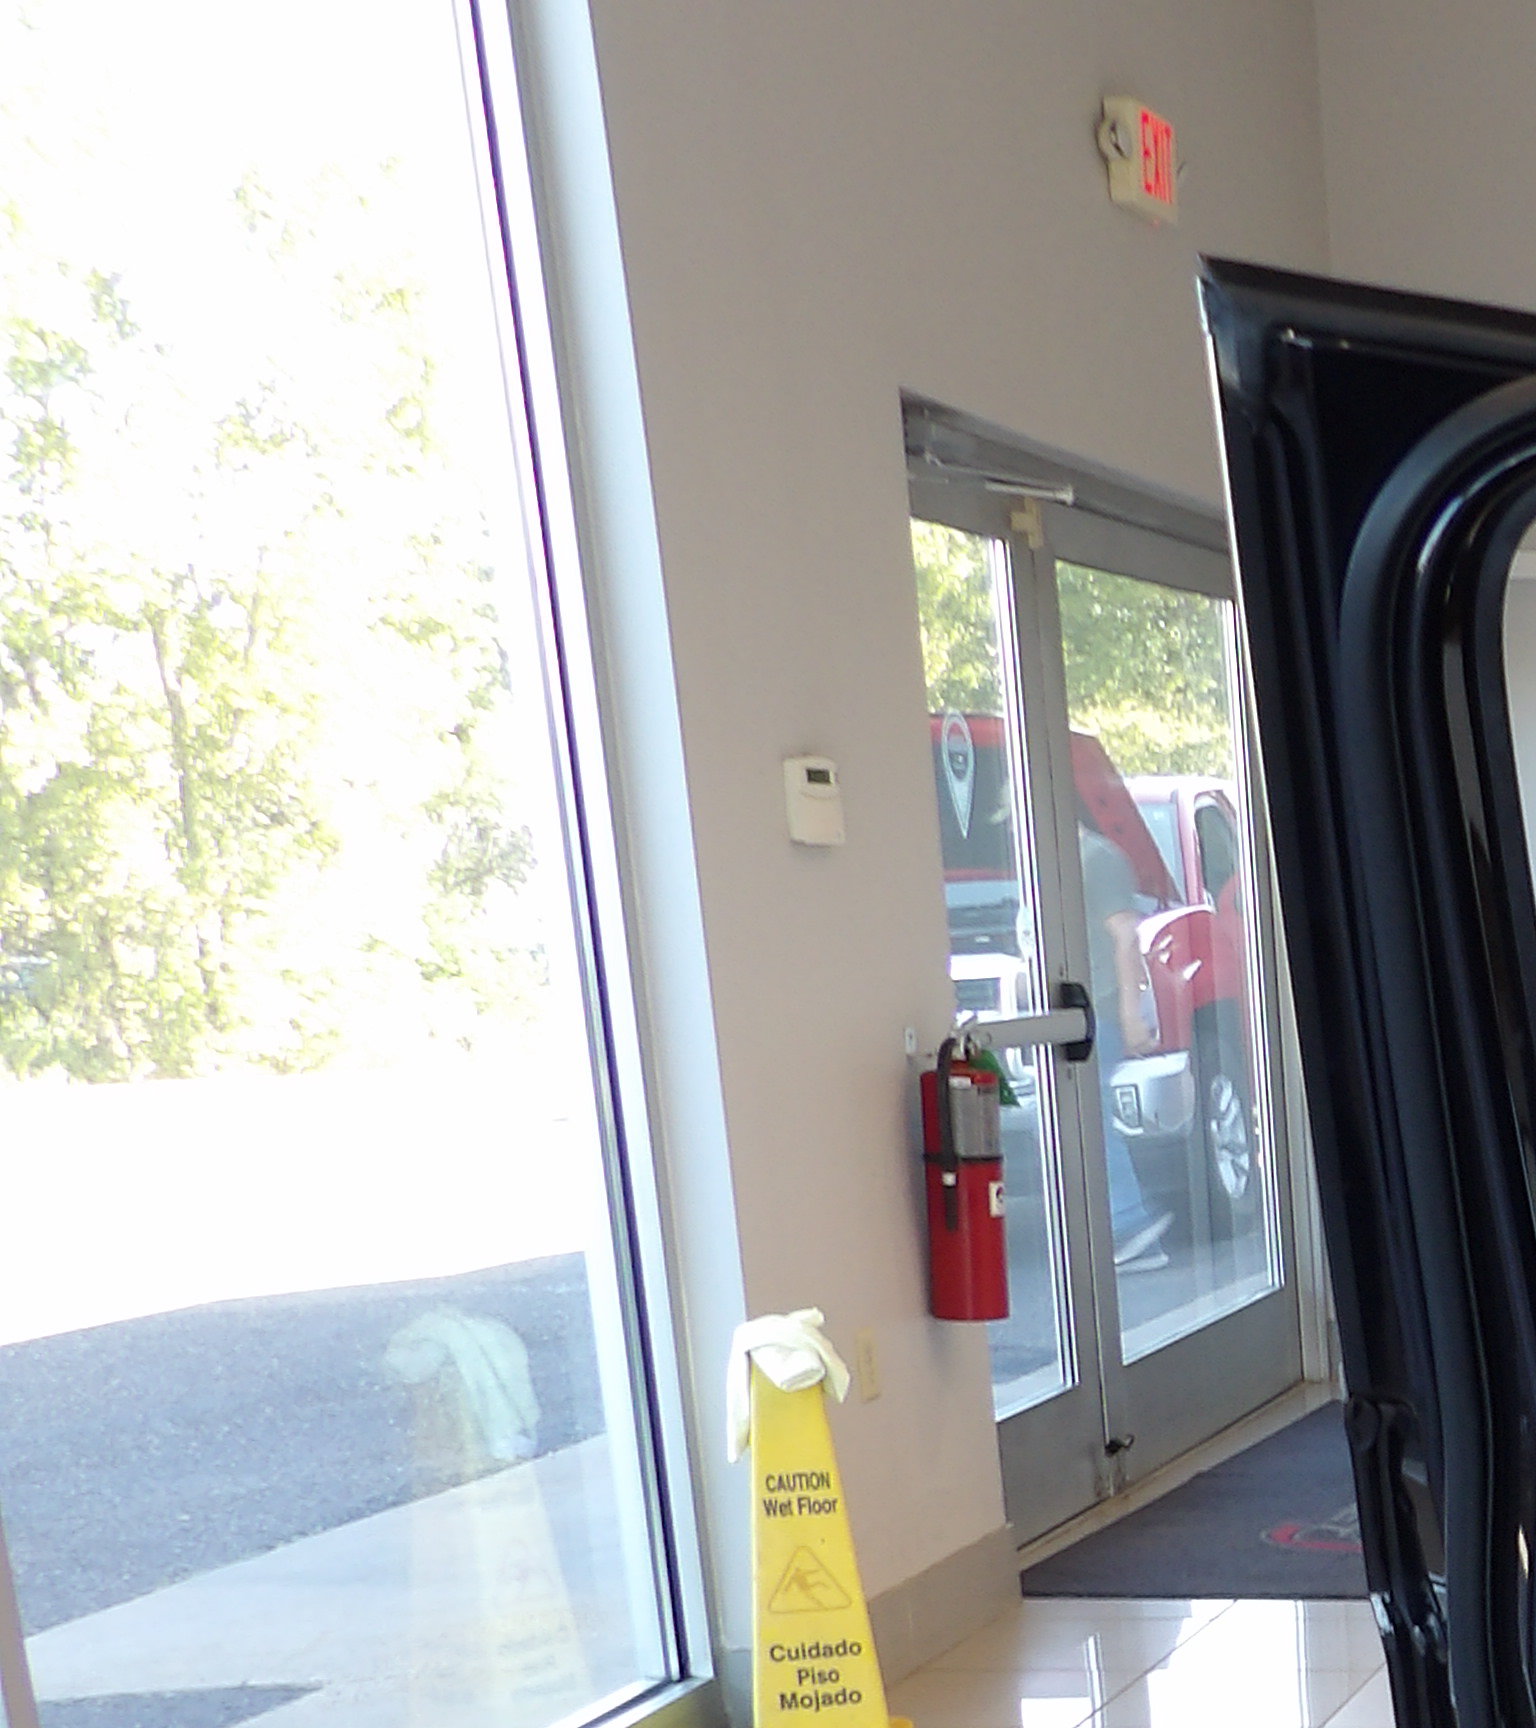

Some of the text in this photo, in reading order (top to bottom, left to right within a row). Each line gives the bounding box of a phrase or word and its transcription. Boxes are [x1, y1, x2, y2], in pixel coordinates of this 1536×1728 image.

[765, 1472, 831, 1493] CAUTION
[763, 1497, 838, 1517] Wet Floor
[769, 1639, 862, 1662] Cuidado
[797, 1667, 840, 1686] Piso
[780, 1688, 862, 1713] Mojado
